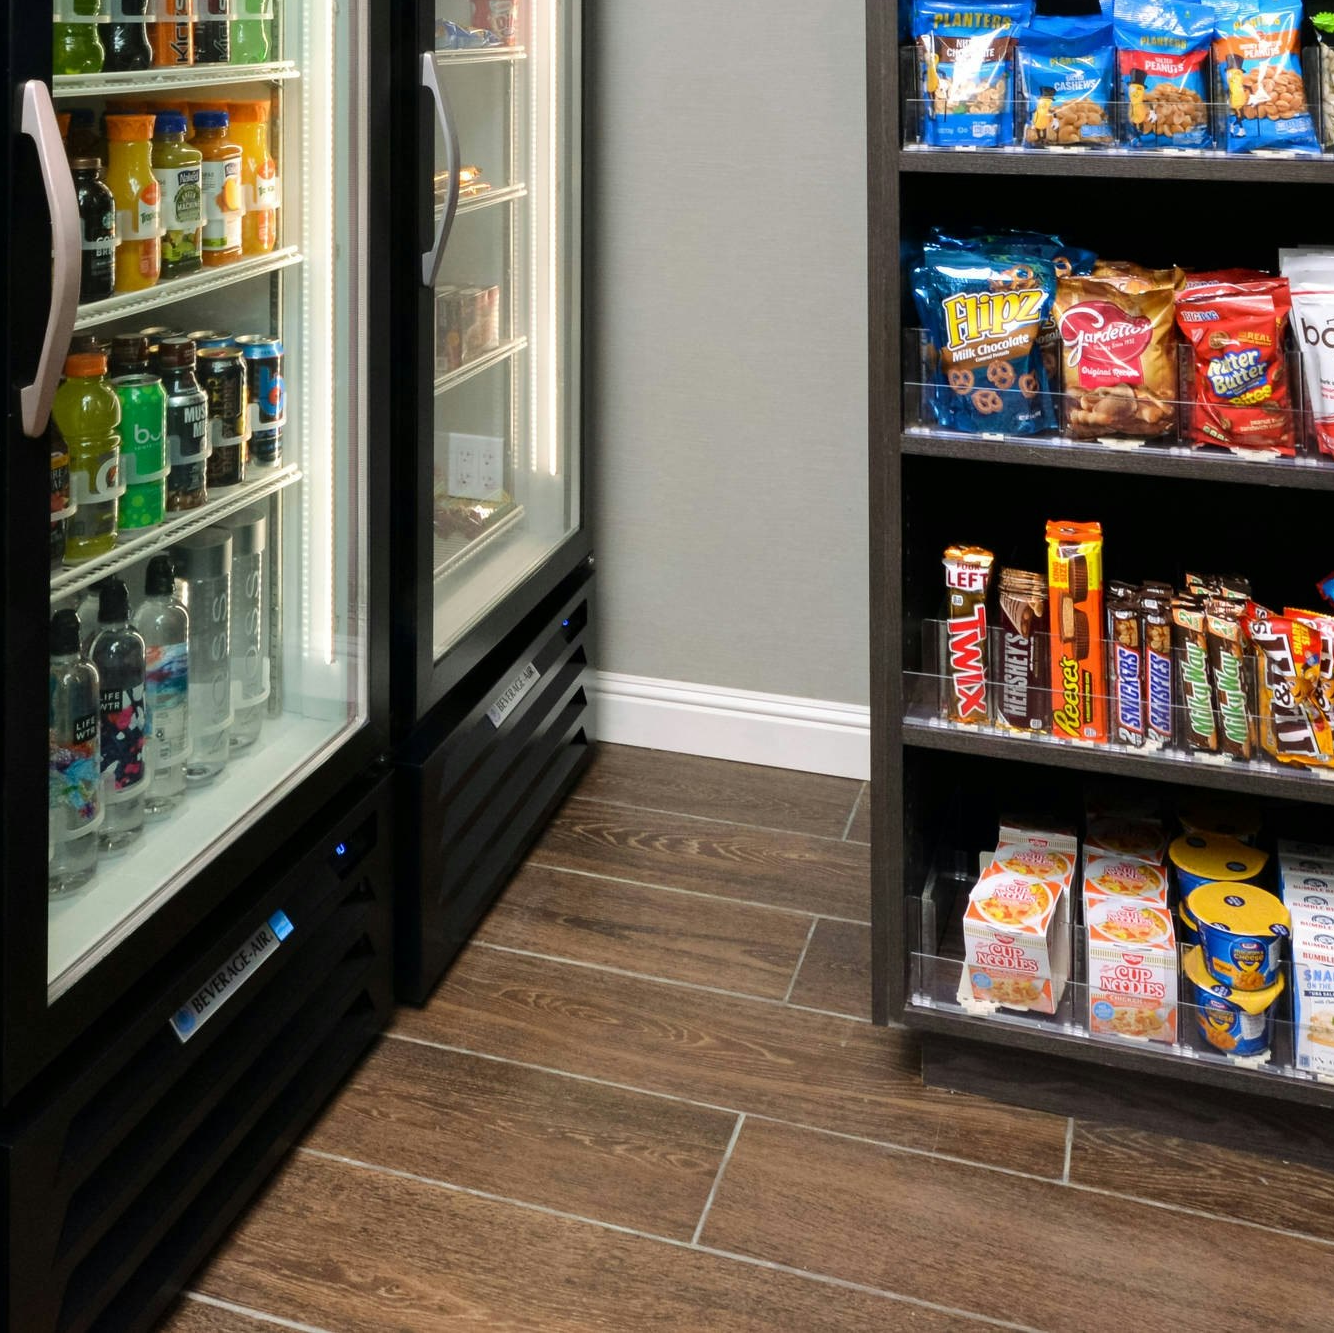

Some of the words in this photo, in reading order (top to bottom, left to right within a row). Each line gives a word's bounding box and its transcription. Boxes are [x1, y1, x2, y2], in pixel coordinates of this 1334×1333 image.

[933, 13, 1012, 30] PLANTERS
[1144, 60, 1185, 74] PEANUTS
[1053, 79, 1097, 92] CASHEWS
[944, 290, 1043, 349] Flipz
[1058, 307, 1154, 367] Gardetto's
[1247, 332, 1272, 342] REAL
[952, 349, 976, 363] Milk
[976, 333, 1030, 358] Chocolate
[1081, 365, 1112, 377] Original
[1208, 349, 1258, 377] Nutter
[1211, 362, 1267, 394] Butter
[1228, 384, 1273, 407] Bites
[948, 572, 989, 588] LEFT
[1292, 623, 1303, 655] SHARE
[1300, 625, 1311, 646] SIZE
[947, 603, 988, 718] TWIX
[1003, 632, 1029, 717] HERSHEY'S
[1053, 656, 1081, 738] Reese's
[76, 715, 95, 731] LIFE
[75, 724, 96, 742] WTR
[994, 889, 1037, 902] NOODLES
[1005, 885, 1028, 896] CUP
[1117, 909, 1140, 920] CUP
[1292, 901, 1324, 911] BUMBLE
[1300, 921, 1332, 932] BUMBLE
[988, 943, 1025, 960] CUP
[1302, 940, 1334, 952] BUMBLE
[976, 951, 1039, 973] NOODLES
[1302, 951, 1334, 964] BUMBLE
[1114, 965, 1152, 984] CUP
[1099, 976, 1166, 998] NOODLES
[1307, 982, 1318, 990] ON
